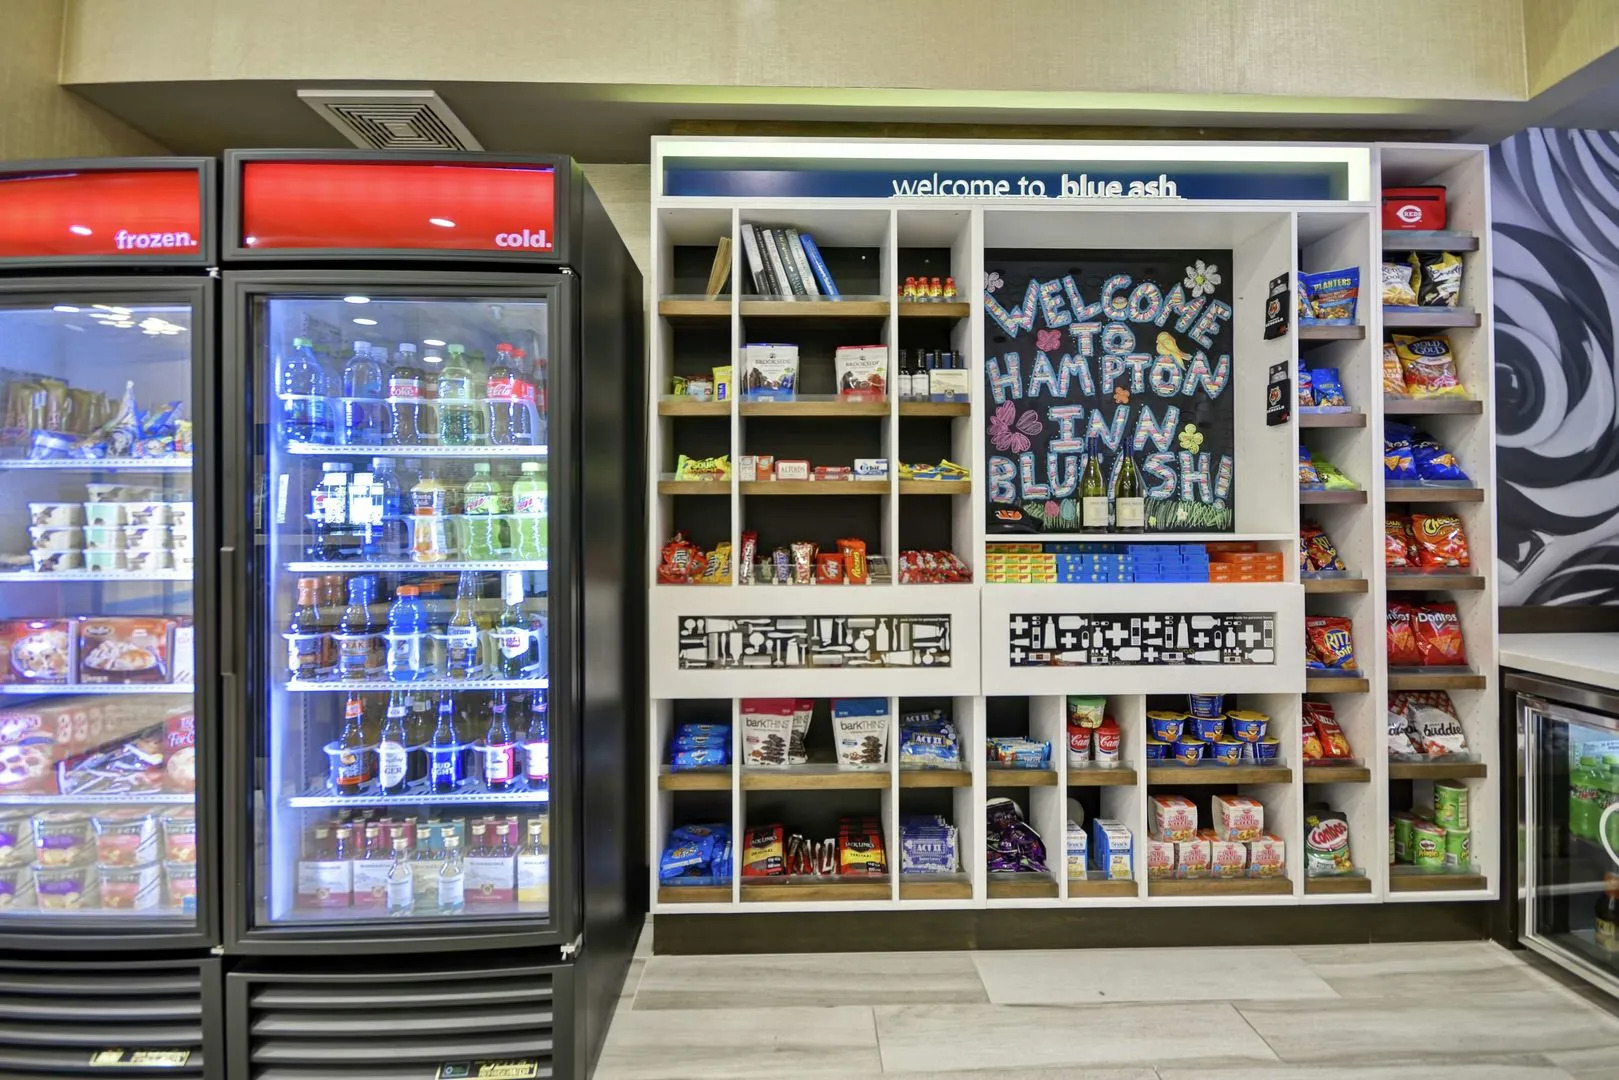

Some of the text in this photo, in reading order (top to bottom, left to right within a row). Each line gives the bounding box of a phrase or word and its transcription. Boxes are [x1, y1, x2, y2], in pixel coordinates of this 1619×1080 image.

[892, 172, 1177, 197] welcome to blue ash
[115, 230, 197, 249] frozen.
[495, 229, 553, 248] cold.
[1313, 278, 1352, 290] PLANTERS
[984, 274, 1233, 350] WELCOME
[1069, 321, 1136, 357] TO
[985, 350, 1231, 404] HAMPTON
[1048, 404, 1181, 452] INN
[1418, 611, 1458, 623] Doritos
[1324, 631, 1351, 650] RITZ
[915, 735, 932, 744] ACT
[1312, 822, 1348, 845] Combos
[915, 842, 932, 852] ACT
